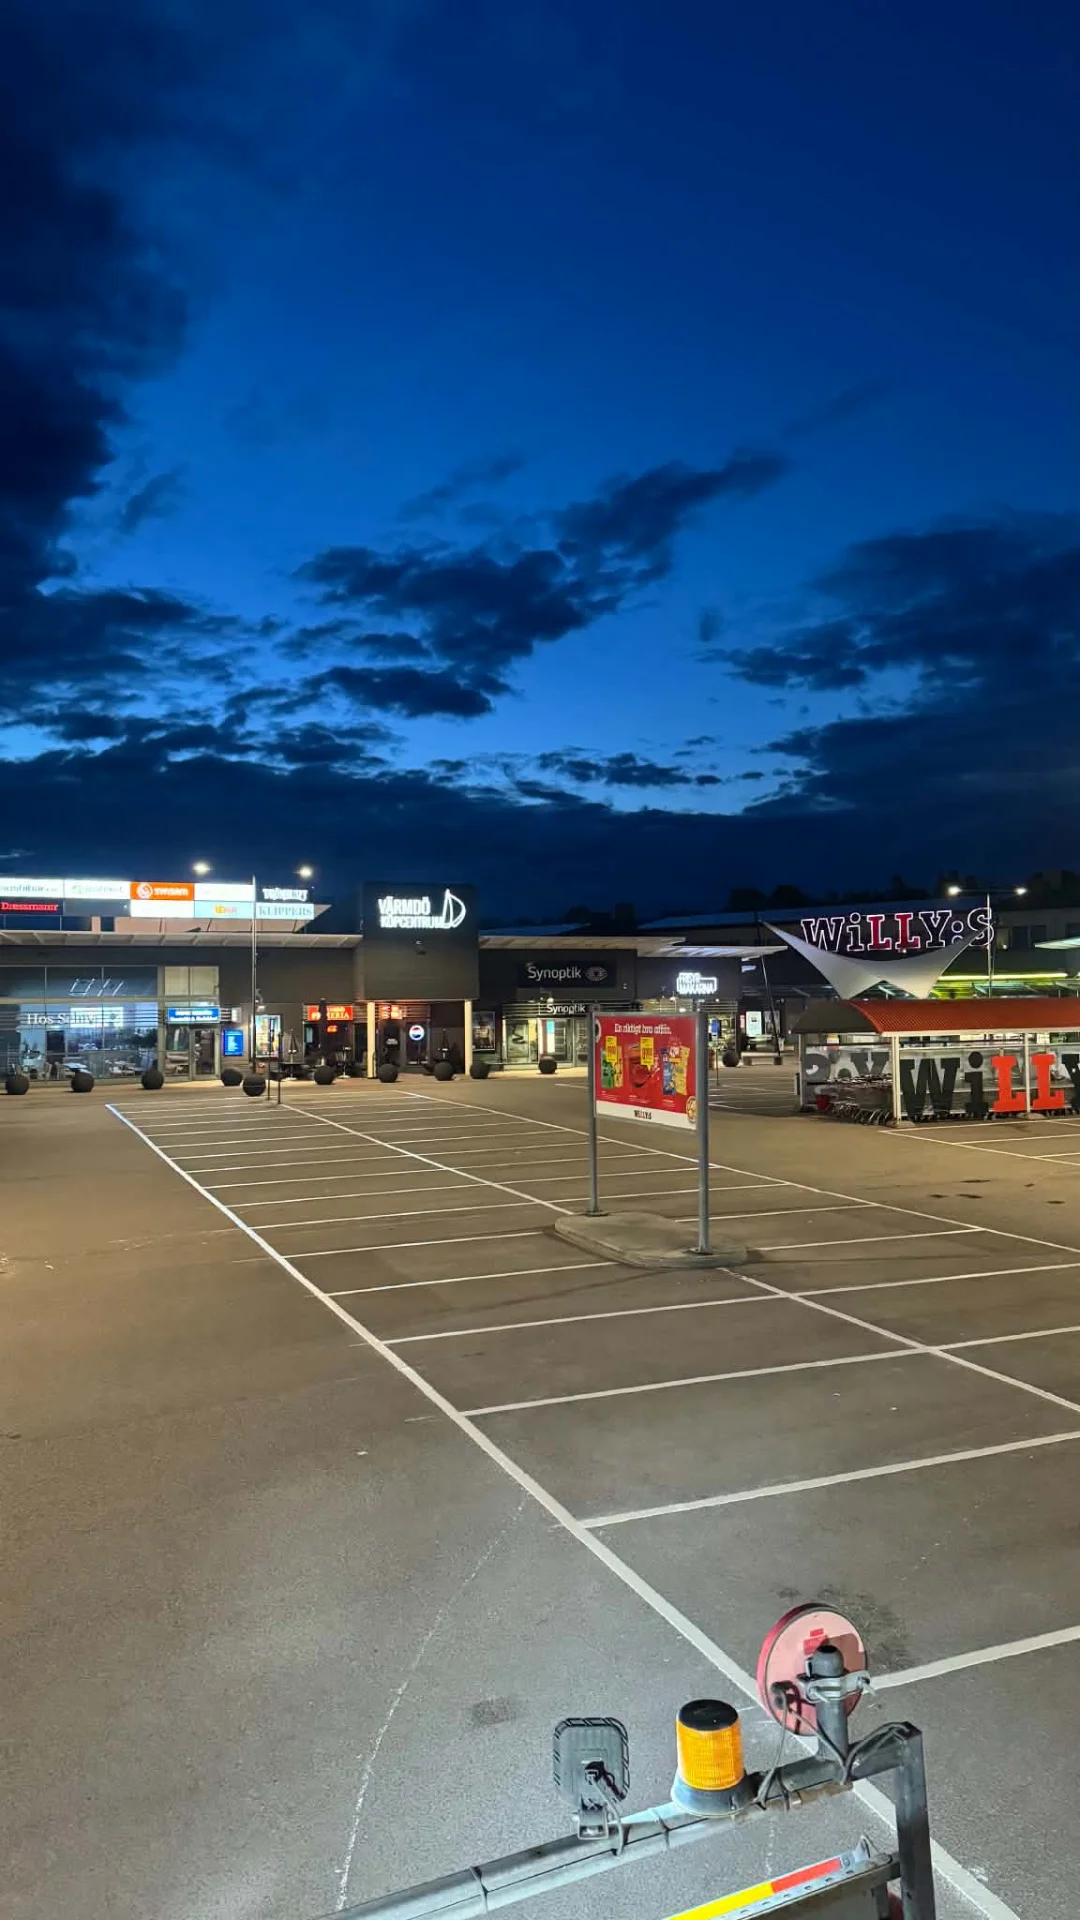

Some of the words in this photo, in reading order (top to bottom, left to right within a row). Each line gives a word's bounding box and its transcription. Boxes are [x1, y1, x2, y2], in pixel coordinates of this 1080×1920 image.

[259, 906, 313, 917] KLIPPERS
[378, 896, 430, 915] VÄRMDÖ
[381, 915, 445, 928] KÖPCENTRUM
[527, 966, 582, 981] Synoptik
[546, 1003, 586, 1014] Synoptik
[27, 1013, 53, 1025] Hos
[615, 1023, 622, 1033] En
[623, 1023, 641, 1035] riktigt
[642, 1024, 653, 1034] bra
